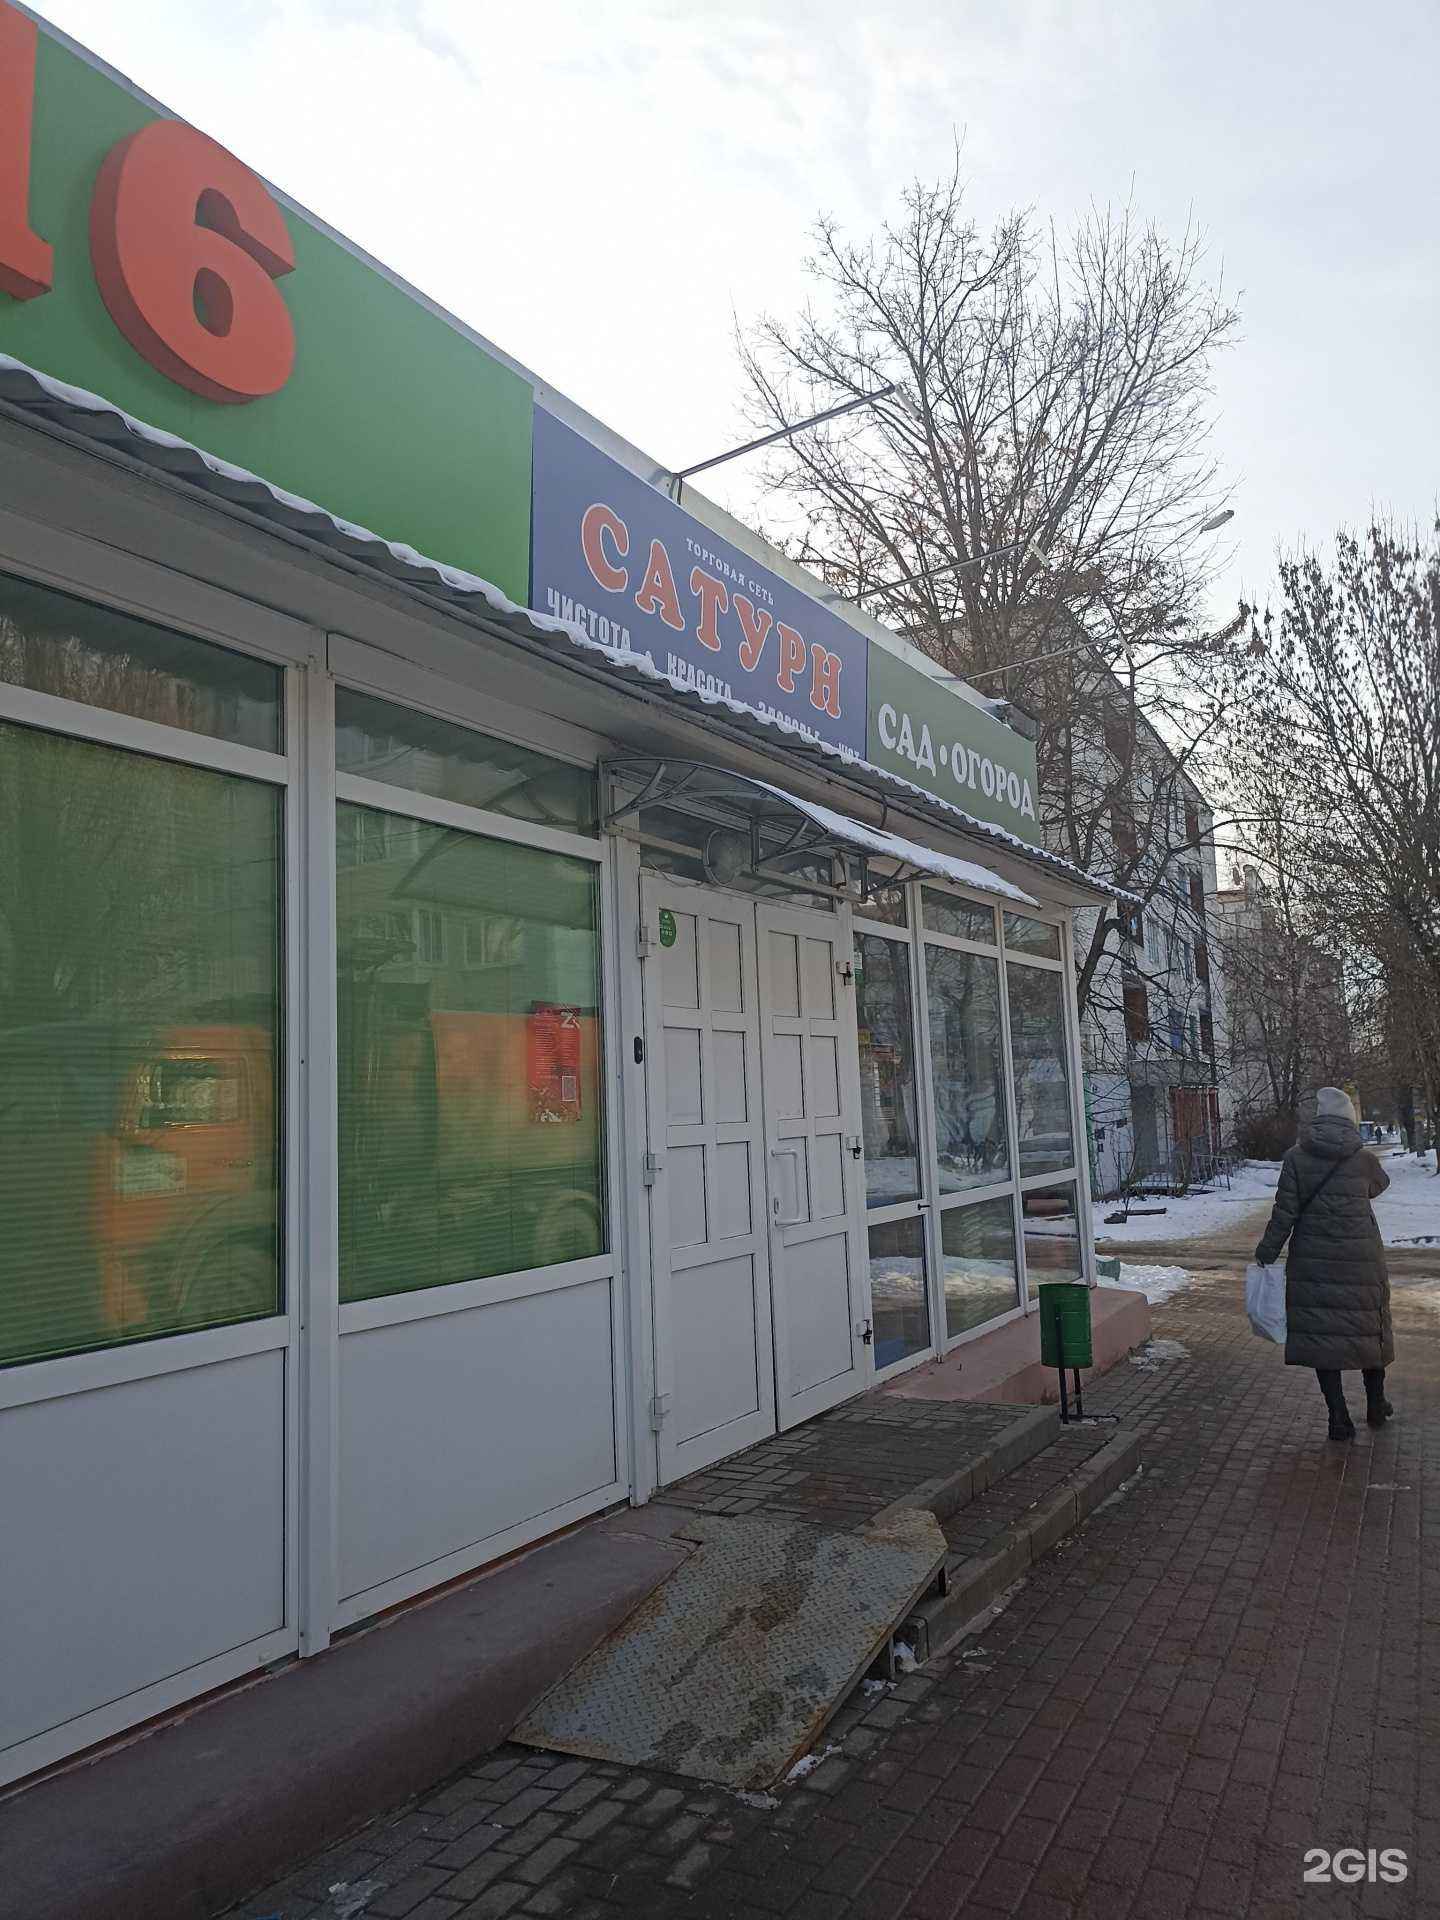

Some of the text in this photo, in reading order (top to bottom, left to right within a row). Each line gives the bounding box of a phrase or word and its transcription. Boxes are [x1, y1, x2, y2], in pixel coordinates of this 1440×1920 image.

[686, 538, 775, 606] ТОРГОВАЯ СЕТЬ
[547, 587, 632, 651] ЧИСТОТА
[581, 502, 843, 719] САТУРН
